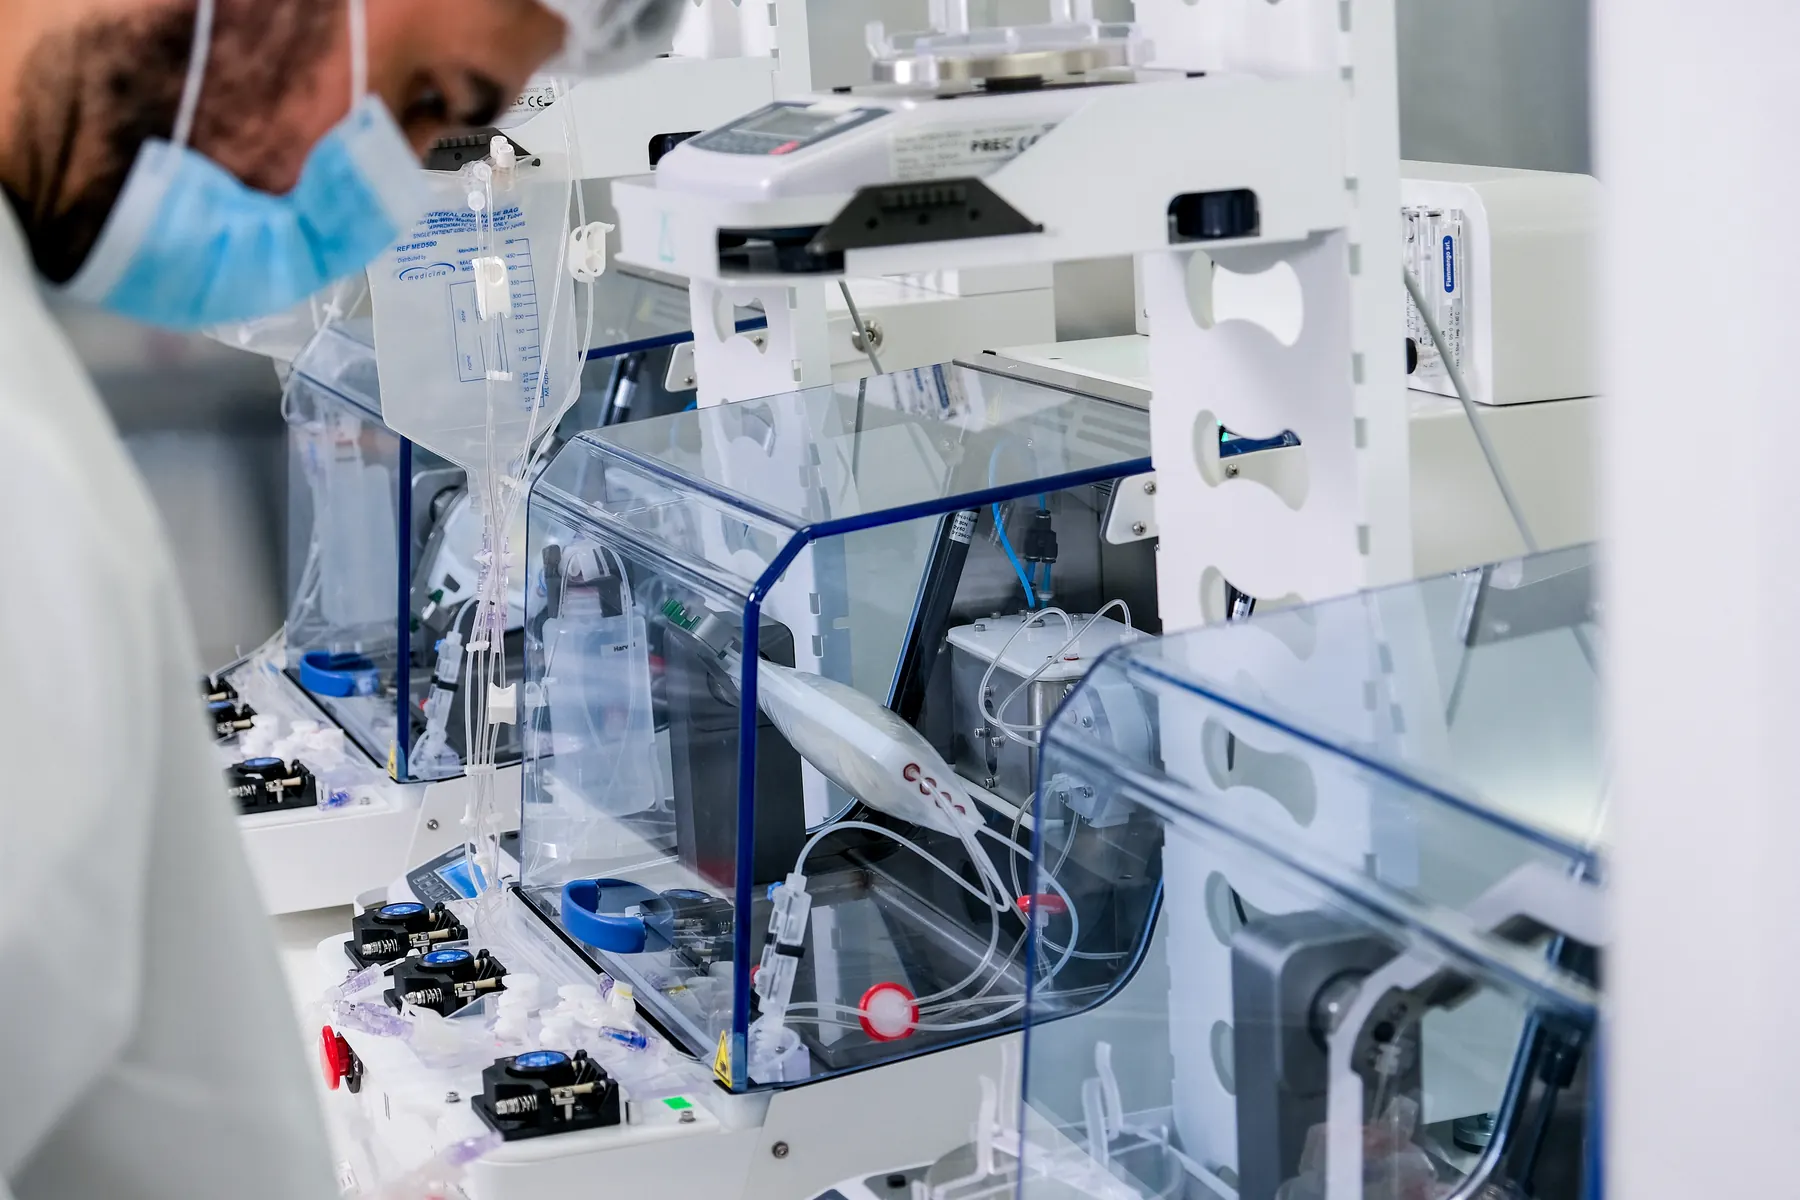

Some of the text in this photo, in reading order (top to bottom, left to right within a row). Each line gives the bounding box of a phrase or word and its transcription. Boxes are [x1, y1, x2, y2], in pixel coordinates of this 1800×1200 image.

[396, 240, 438, 253] REF MED500
[407, 270, 447, 281] medicina
